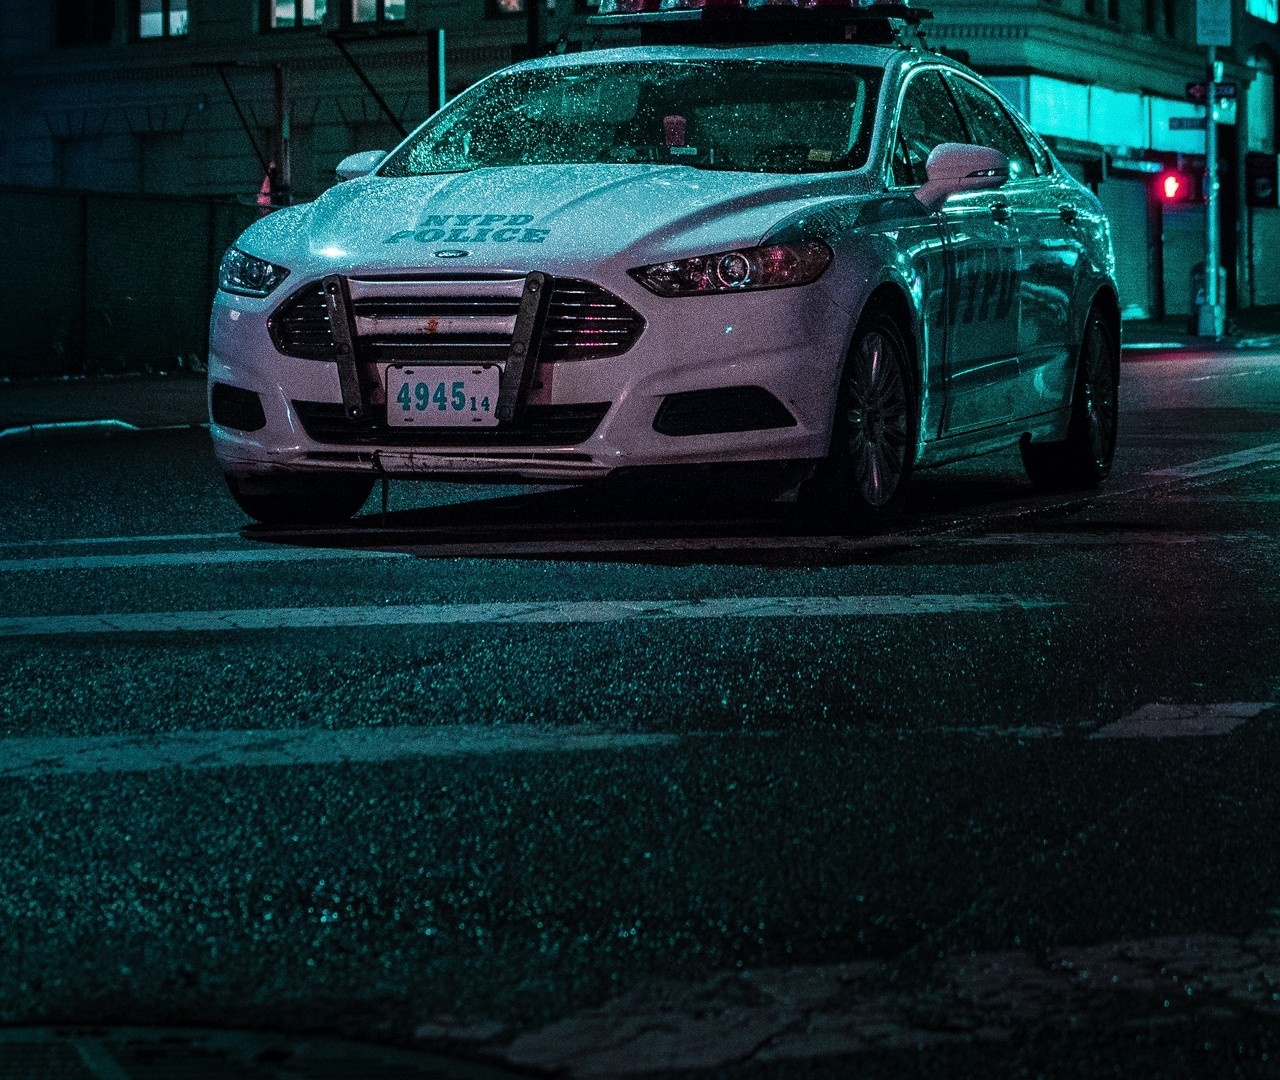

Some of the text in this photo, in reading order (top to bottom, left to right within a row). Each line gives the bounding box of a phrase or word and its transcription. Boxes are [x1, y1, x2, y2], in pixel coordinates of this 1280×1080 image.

[420, 214, 535, 227] NYPD
[382, 228, 552, 244] POLICE
[396, 382, 490, 411] 4945 14
